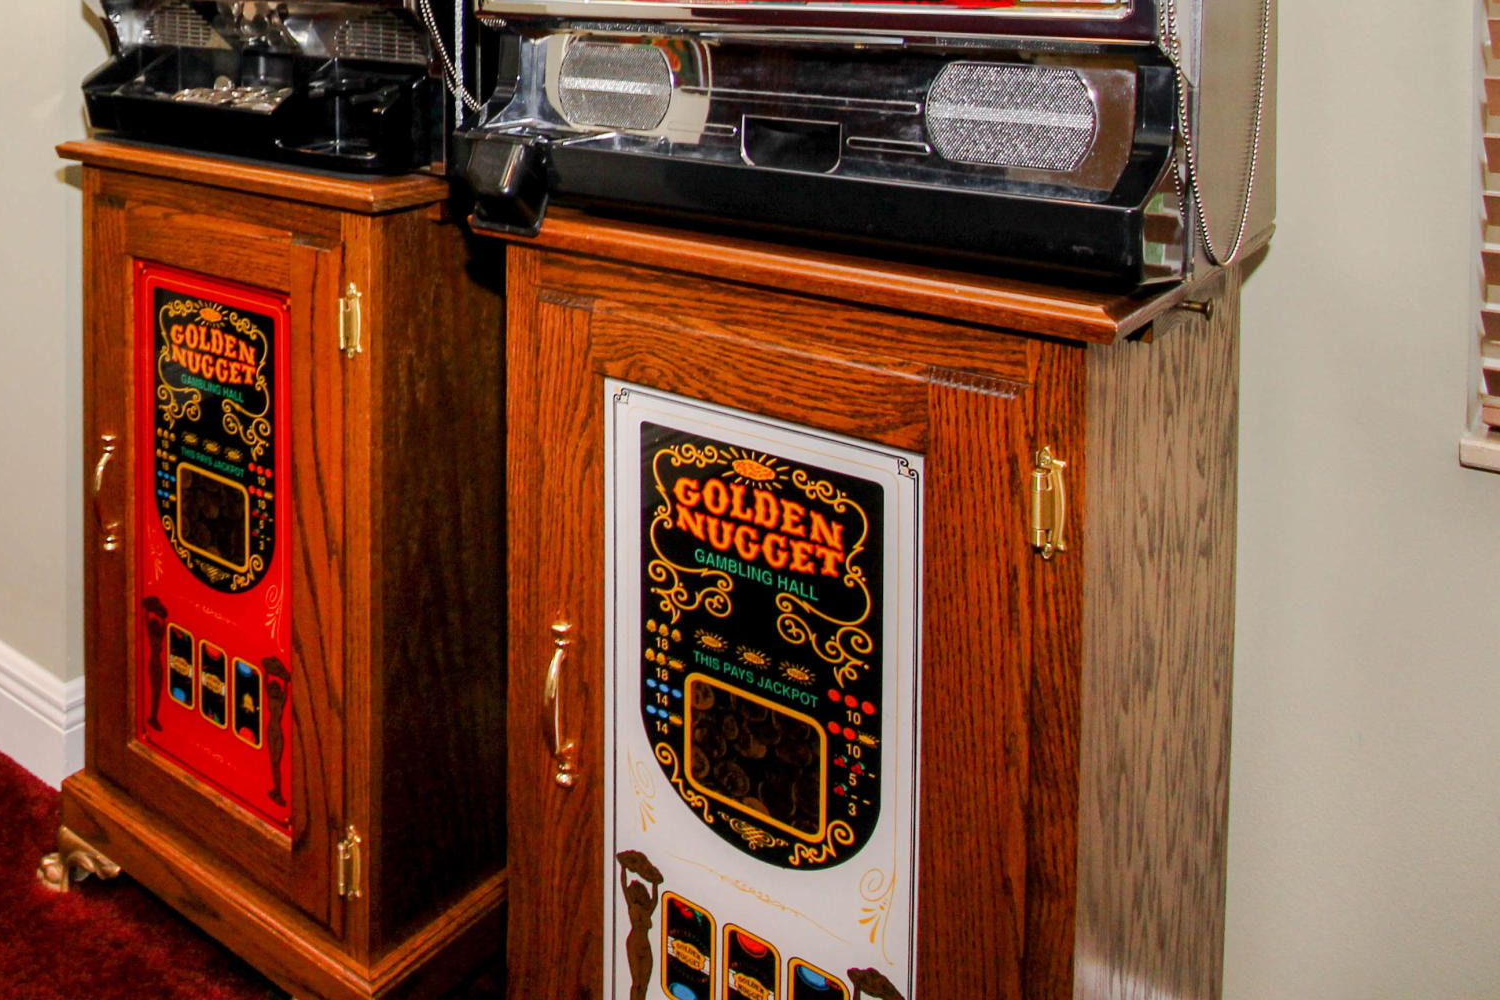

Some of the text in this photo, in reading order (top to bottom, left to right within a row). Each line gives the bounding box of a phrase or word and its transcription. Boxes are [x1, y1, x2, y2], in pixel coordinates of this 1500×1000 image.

[171, 323, 257, 366] GOLDEN
[171, 344, 257, 385] NUGGET
[181, 373, 244, 403] GAMBLING HALL
[672, 476, 844, 552] GOLDEN
[674, 502, 845, 578] NUGGET
[694, 547, 818, 601] GAMBLING HALL
[655, 636, 670, 651] 18
[655, 667, 670, 682] 18
[692, 649, 819, 709] THIS PAYS JACKPOT
[655, 692, 670, 707] 14
[845, 709, 862, 726] 10
[655, 720, 670, 735] 14
[845, 743, 862, 759] 10
[848, 772, 858, 787] 5
[847, 802, 857, 817] 3
